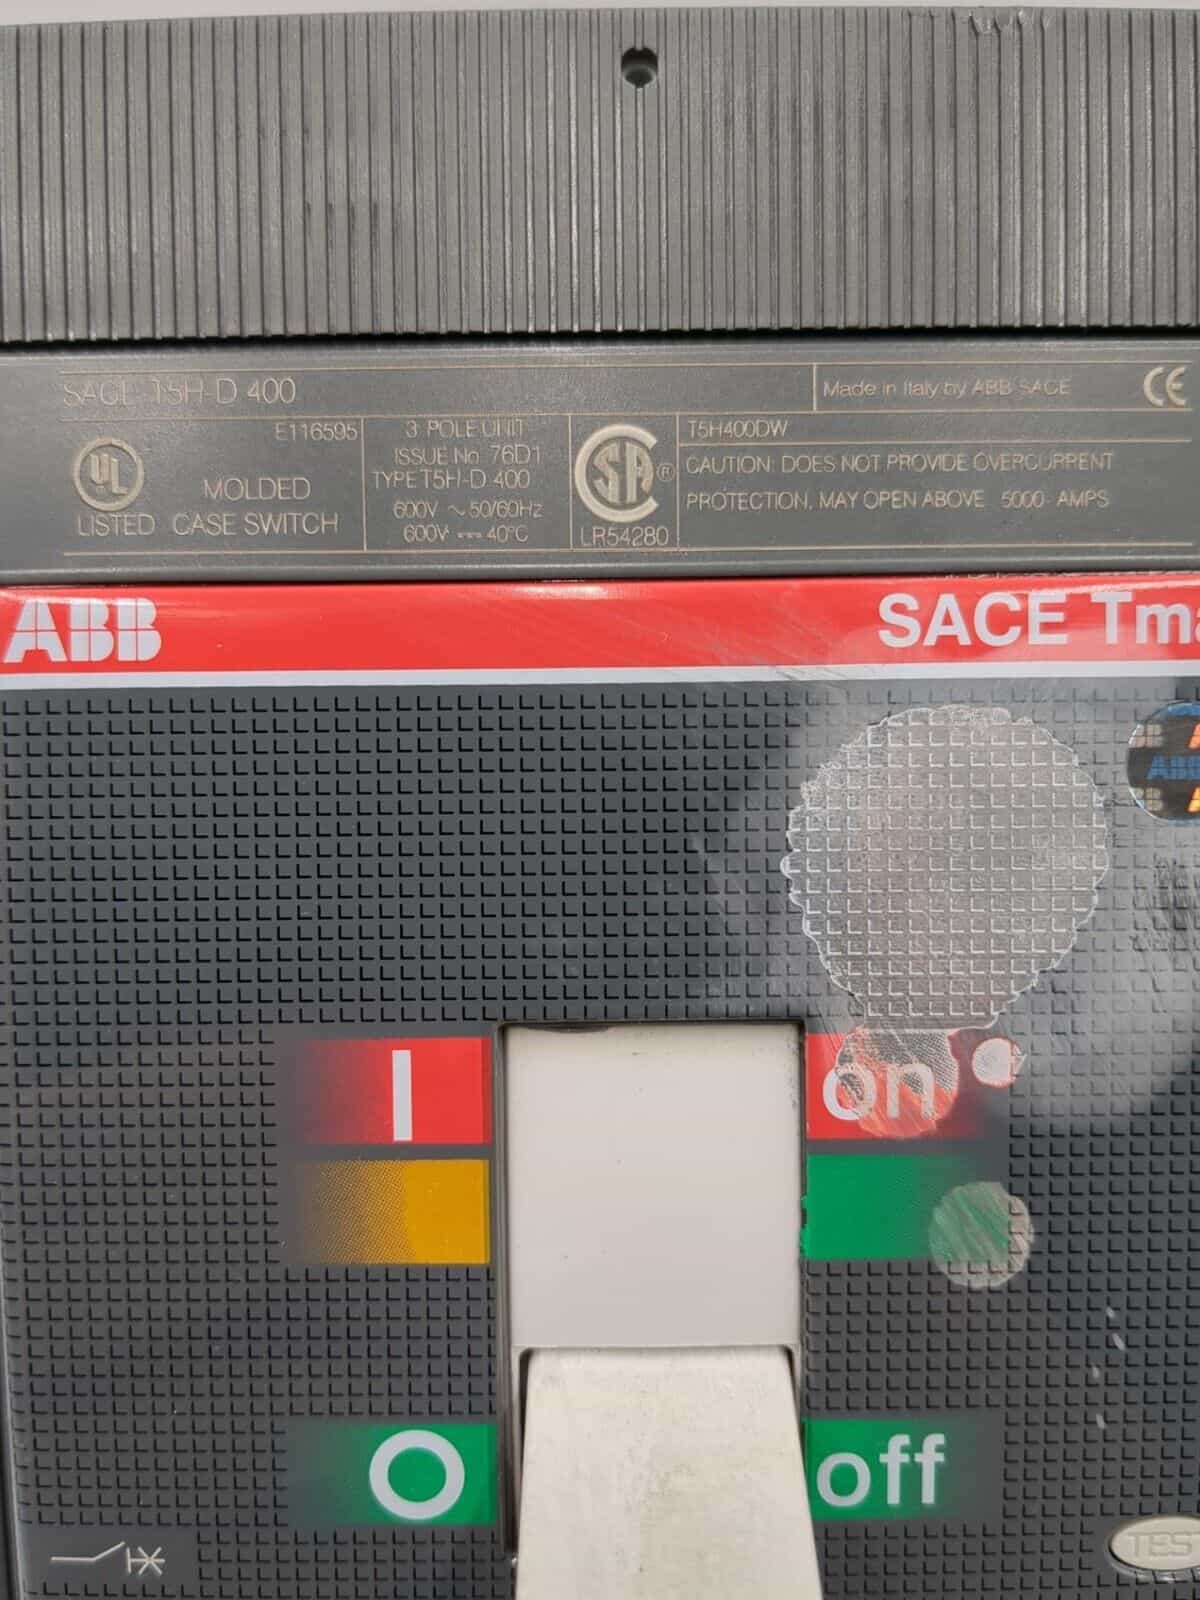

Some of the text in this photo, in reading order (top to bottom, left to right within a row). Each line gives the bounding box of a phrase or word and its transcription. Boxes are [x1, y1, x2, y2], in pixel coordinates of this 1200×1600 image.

[247, 376, 297, 404] 400
[823, 377, 1072, 400] Made in Italy by ABB SACE
[1143, 366, 1188, 407] CE
[275, 422, 358, 441] E116595
[406, 417, 524, 438] 3 POLE UNIT
[688, 419, 788, 439] T5H400DW
[394, 446, 448, 466] ISSUE
[488, 443, 541, 466] 76D1
[782, 454, 836, 474] DOES
[841, 454, 881, 473] NOT
[887, 453, 969, 473] PROVIDE
[973, 451, 1114, 472] OVERCURRENT
[203, 476, 312, 501] MOLDED
[371, 470, 417, 489] TYPE
[493, 468, 530, 490] 400
[392, 500, 440, 519] 600V
[819, 489, 859, 510] MAY
[863, 489, 917, 510] OPEN
[922, 488, 985, 509] ABOVE
[1001, 488, 1046, 510] 5000
[1055, 488, 1110, 509] AMPS
[77, 512, 156, 537] LISTED
[172, 511, 339, 537] CASE SWITCH
[403, 524, 450, 543] 600V
[580, 525, 669, 547] LR54280
[3, 596, 163, 664] ABB
[877, 590, 1200, 648] SACE Tm
[823, 1061, 935, 1121] on
[816, 1432, 946, 1508] off
[1127, 1530, 1200, 1557] TES
